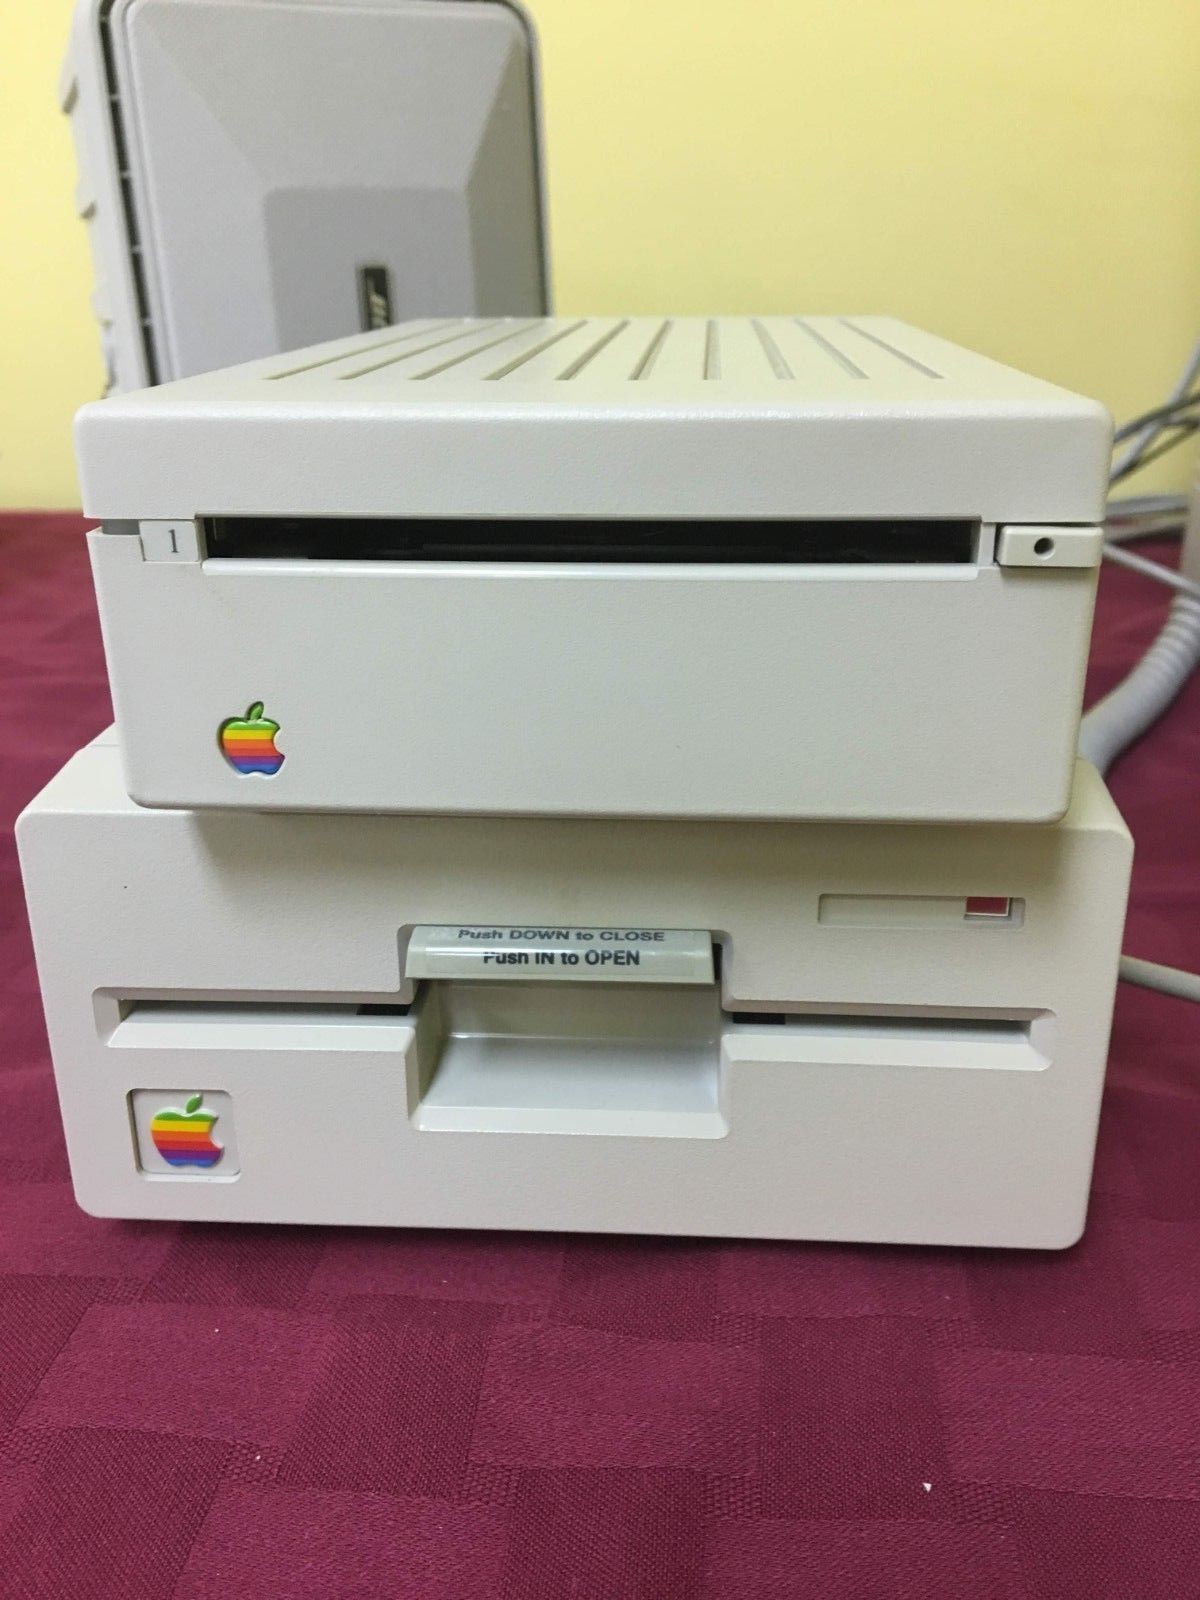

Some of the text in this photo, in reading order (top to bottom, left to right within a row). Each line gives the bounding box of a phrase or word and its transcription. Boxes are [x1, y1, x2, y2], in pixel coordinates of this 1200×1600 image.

[168, 529, 179, 553] 1
[458, 929, 665, 942] Push DOWN to CLOSE
[483, 949, 641, 966] Push IN to OPEN
